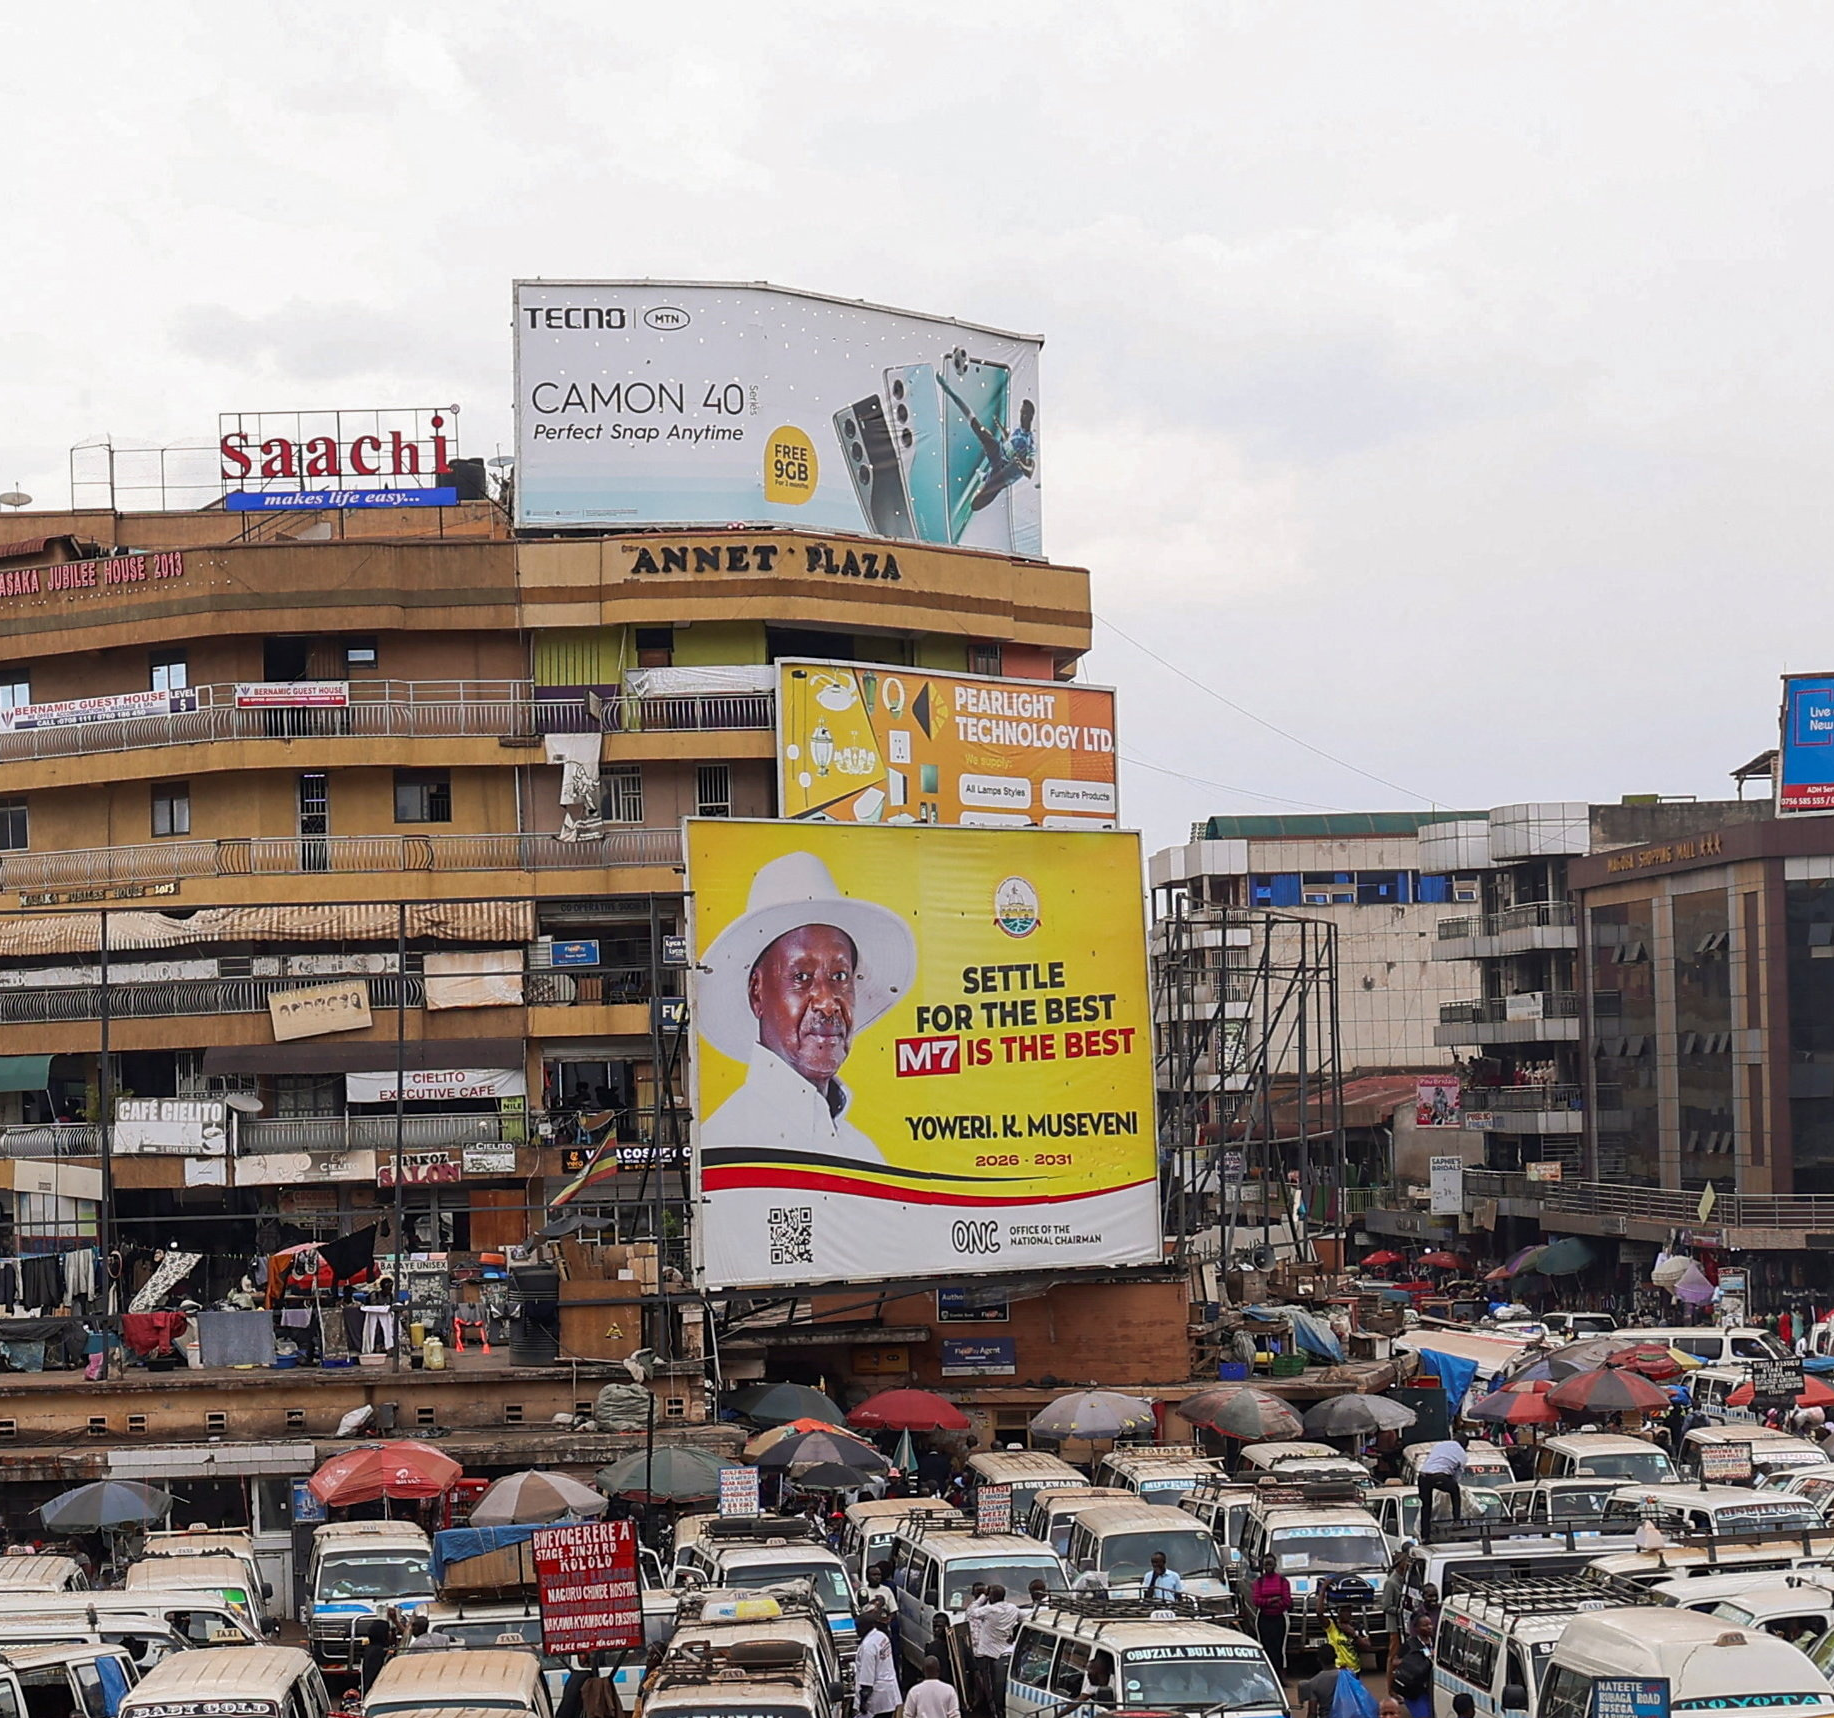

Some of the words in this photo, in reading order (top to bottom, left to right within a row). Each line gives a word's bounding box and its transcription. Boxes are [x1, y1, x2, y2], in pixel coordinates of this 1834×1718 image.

[523, 307, 625, 329] TECNO
[654, 313, 680, 324] MTN
[532, 382, 684, 415] CAMON
[702, 383, 745, 415] 40
[749, 385, 759, 416] Series
[534, 423, 602, 440] Perfect
[610, 423, 659, 443] Snap
[666, 424, 744, 443] Anytime
[220, 415, 453, 479] Saachi
[774, 443, 808, 461] FREE
[773, 461, 809, 481] 9GB
[264, 492, 323, 508] makes
[329, 490, 358, 507] life
[364, 491, 419, 508] easy...
[48, 564, 96, 592] JUBILEE
[105, 557, 146, 585] HOUSE
[154, 552, 183, 579] 2013
[631, 545, 778, 574] ANNET
[805, 545, 901, 580] PLAZA
[14, 701, 77, 716] BERNAMIC
[79, 695, 121, 709] GUEST
[123, 690, 166, 705] HOUSE
[170, 689, 196, 698] LEVEL
[954, 686, 1055, 720] PEARLIGHT
[179, 698, 187, 711] 5
[954, 716, 1079, 750] TECHNOLOGY
[1083, 727, 1114, 753] LTD.
[966, 783, 978, 793] All
[978, 784, 1002, 797] Lamps
[1003, 786, 1026, 799] Styles
[1050, 789, 1080, 799] Furniture
[1082, 790, 1110, 801] Products
[962, 961, 1066, 995] SETTLE
[916, 1003, 973, 1034] FOR
[980, 997, 1037, 1029] THE
[1046, 993, 1116, 1023] BEST
[898, 1040, 958, 1073] M7
[967, 1038, 992, 1066] IS
[999, 1032, 1056, 1063] THE
[1066, 1028, 1136, 1058] BEST
[413, 1071, 466, 1084] CIELITO
[379, 1087, 456, 1101] EXECUTIVE
[119, 1099, 158, 1121] CAFÉ
[161, 1101, 222, 1121] CIELITO
[905, 1114, 998, 1141] YOWERI.
[1002, 1113, 1023, 1138] K.
[1027, 1111, 1138, 1137] MUSEVENI
[975, 1154, 1020, 1167] 2026
[1035, 1153, 1072, 1165] 2031
[378, 1161, 461, 1187] SALON
[952, 1219, 1001, 1255] ONC
[1009, 1225, 1040, 1236] OFFICE
[1041, 1225, 1053, 1235] OF
[1054, 1224, 1070, 1234] THE
[1010, 1235, 1055, 1247] NATIONAL
[1057, 1233, 1102, 1246] CHAIRMAN
[533, 1527, 619, 1549] BWEYOGERERE
[559, 1556, 612, 1571] KOLOLO
[215, 1628, 237, 1637] TAXI
[1185, 1647, 1214, 1658] BULI
[1598, 1681, 1643, 1692] NATEETE
[1598, 1692, 1632, 1704] RUBAGA
[1636, 1693, 1661, 1705] ROAD
[1681, 1692, 1823, 1709] TOYOTA
[133, 1703, 199, 1718] BABY
[203, 1701, 269, 1715] GOLD
[1598, 1703, 1634, 1714] BUSEGA
